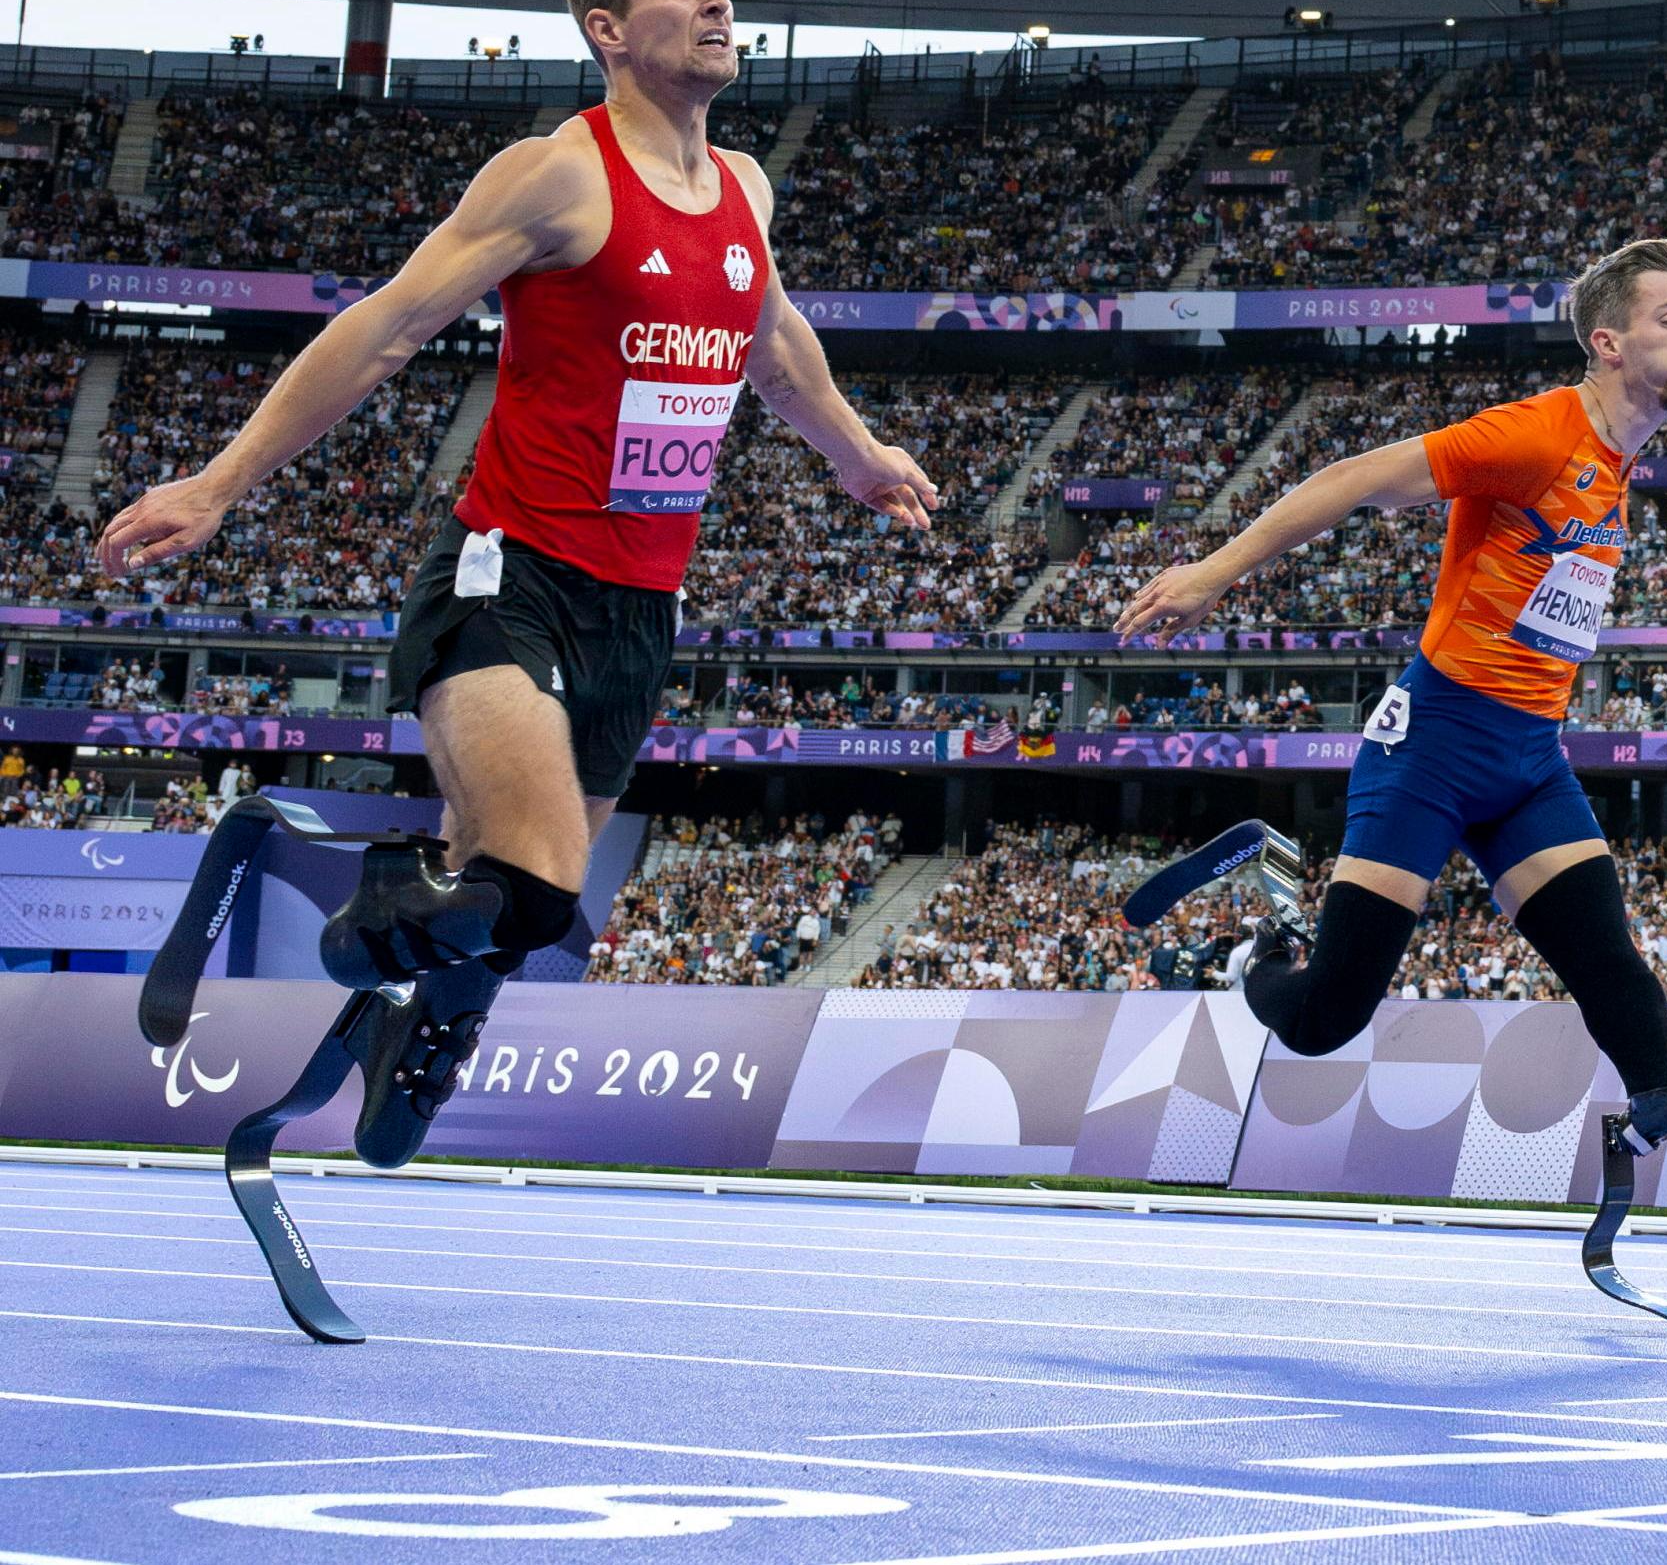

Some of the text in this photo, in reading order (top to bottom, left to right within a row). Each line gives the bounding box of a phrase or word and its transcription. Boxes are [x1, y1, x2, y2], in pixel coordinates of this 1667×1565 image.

[88, 273, 252, 298] PARIS 2024
[1289, 298, 1436, 318] PARIS 2024
[620, 321, 753, 372] GERMANY
[657, 394, 731, 416] TOYOTA
[663, 496, 695, 508] PARIS
[1570, 562, 1608, 588] TOYOTA
[1377, 699, 1402, 731] 5
[284, 729, 305, 746] J3
[363, 731, 385, 749] J2
[840, 738, 935, 756] PARIS 20
[1077, 745, 1101, 763] H4
[1613, 744, 1638, 763] H2
[22, 903, 164, 922] PARIS 2024
[456, 1046, 759, 1101] ARIS 2024
